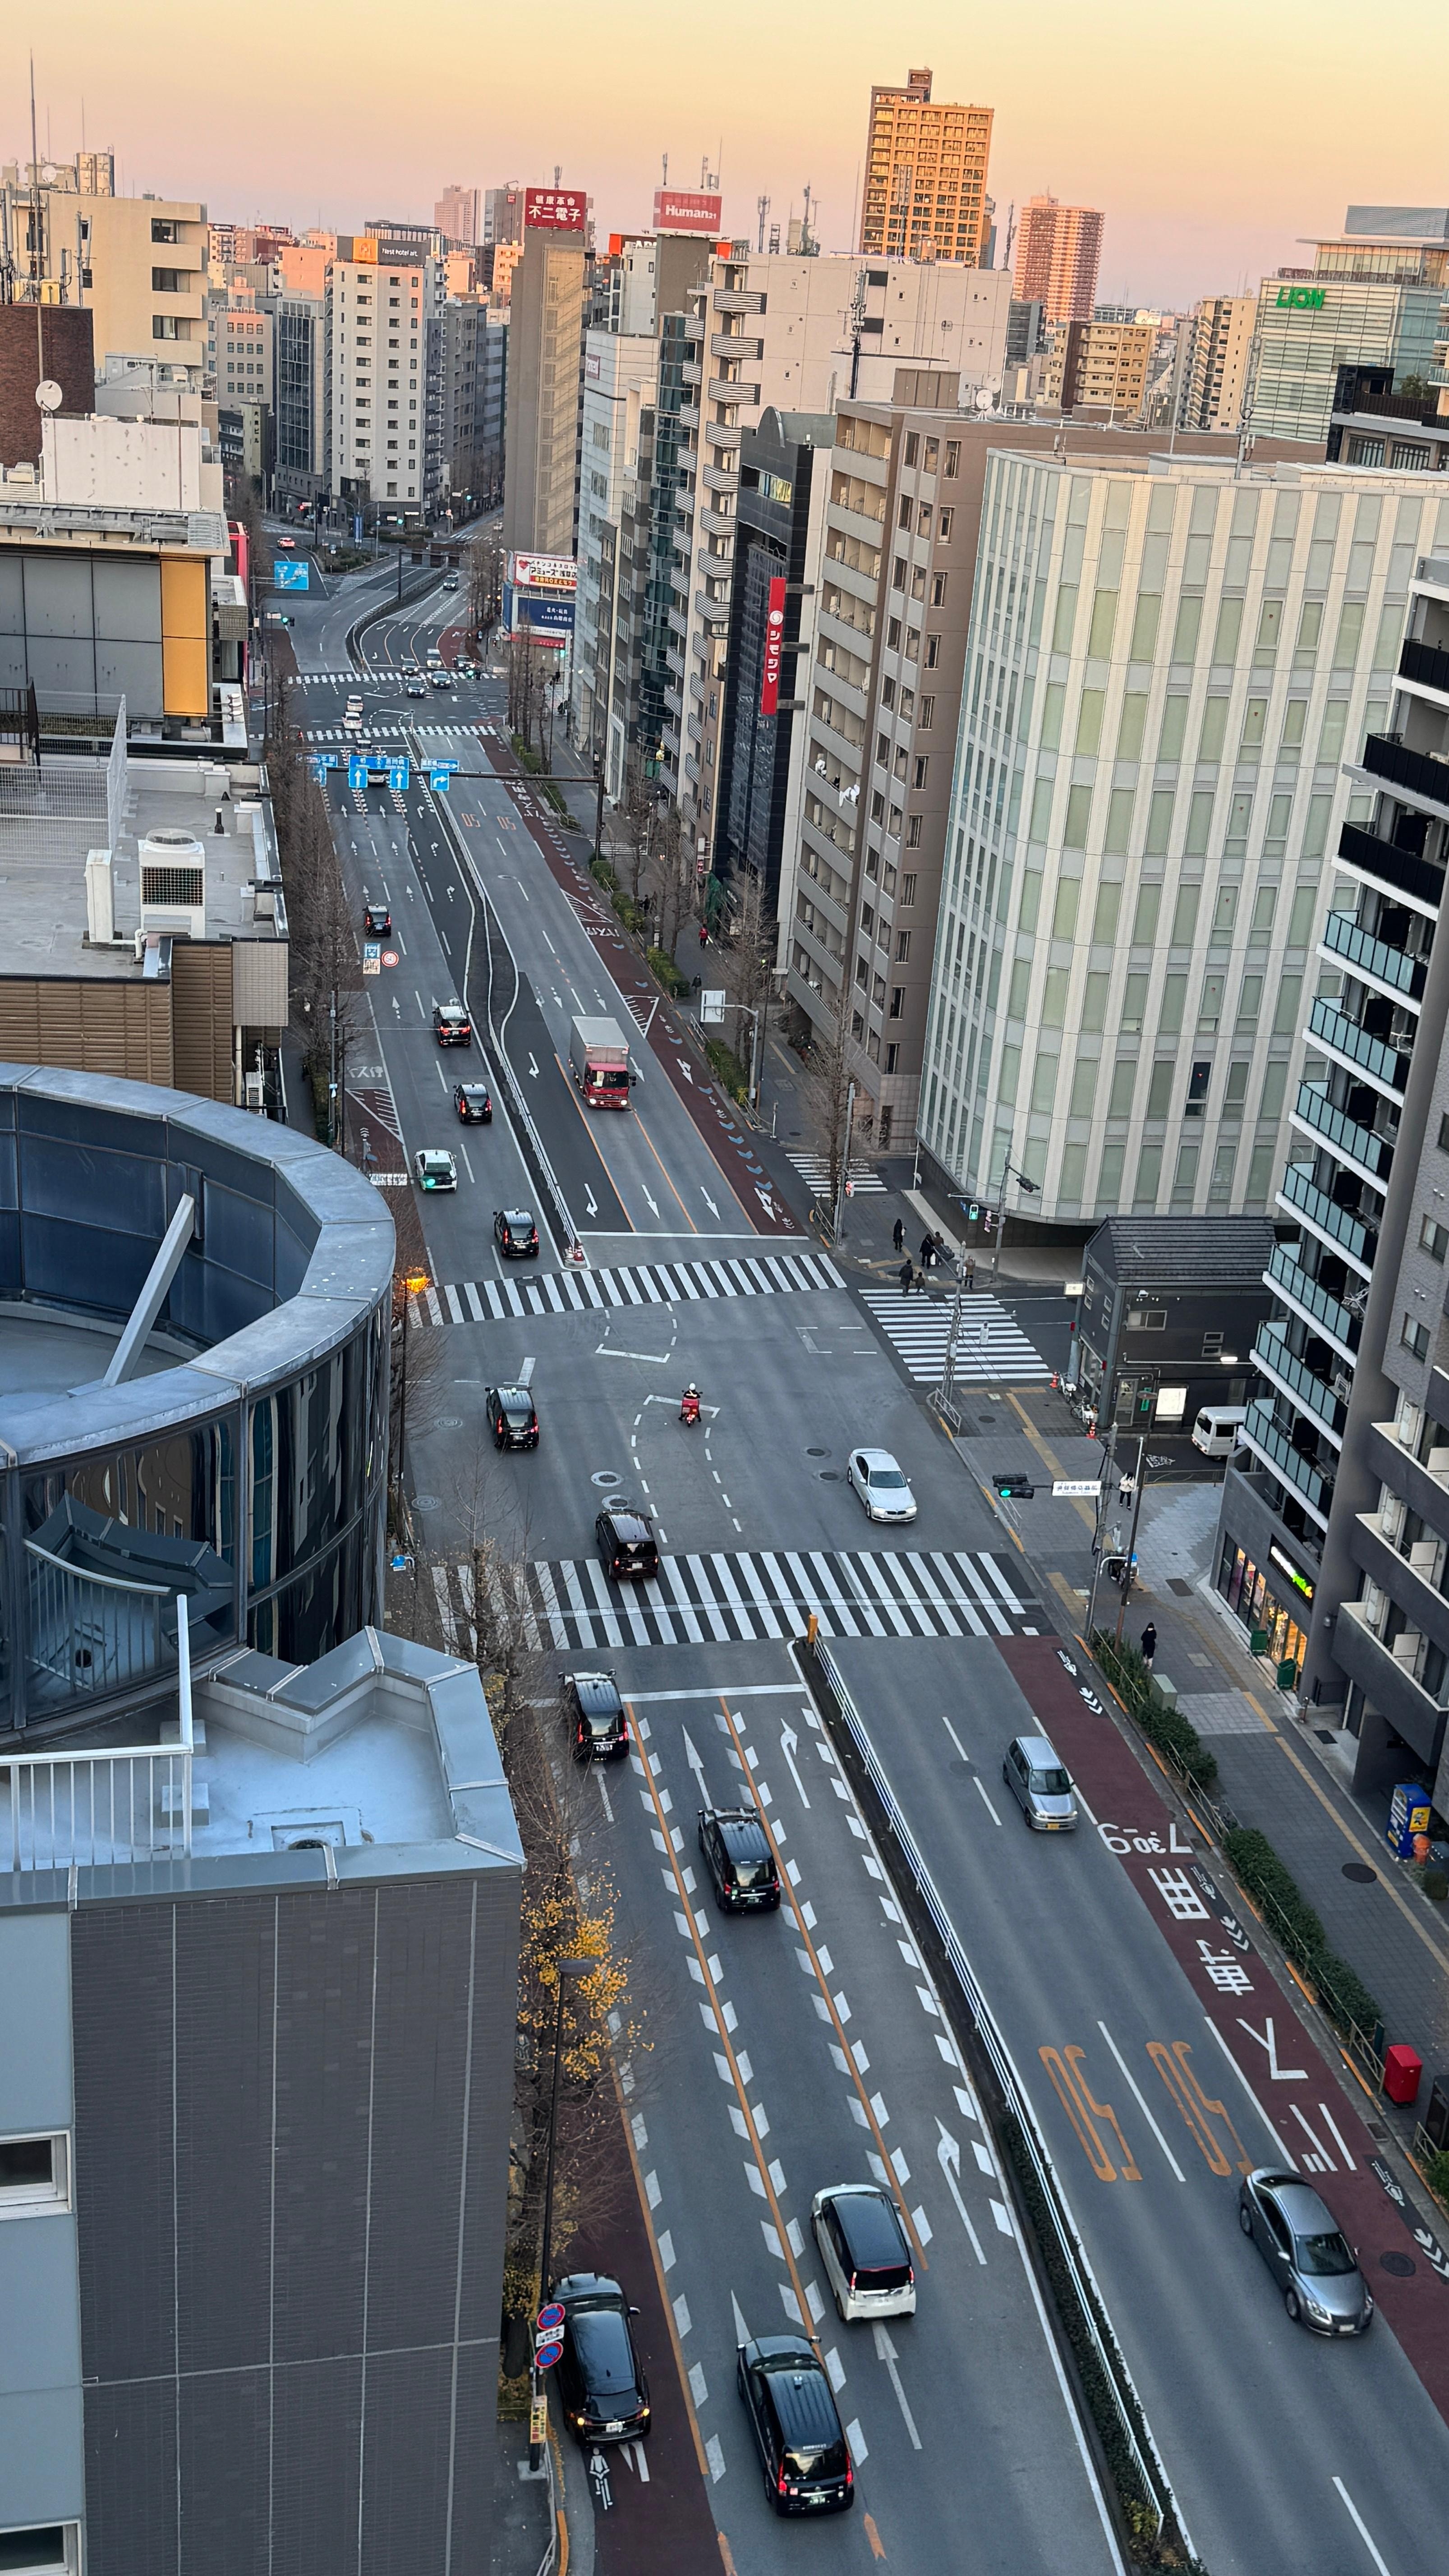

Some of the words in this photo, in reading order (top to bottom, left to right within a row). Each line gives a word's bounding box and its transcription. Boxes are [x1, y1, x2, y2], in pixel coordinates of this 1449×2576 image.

[529, 205, 581, 222] 不二電子
[1276, 286, 1327, 310] LION
[767, 630, 780, 683] シモジマ
[461, 813, 481, 828] 50
[497, 815, 516, 830] 50
[1038, 2044, 1143, 2182] 50
[1146, 2041, 1255, 2176] 50
